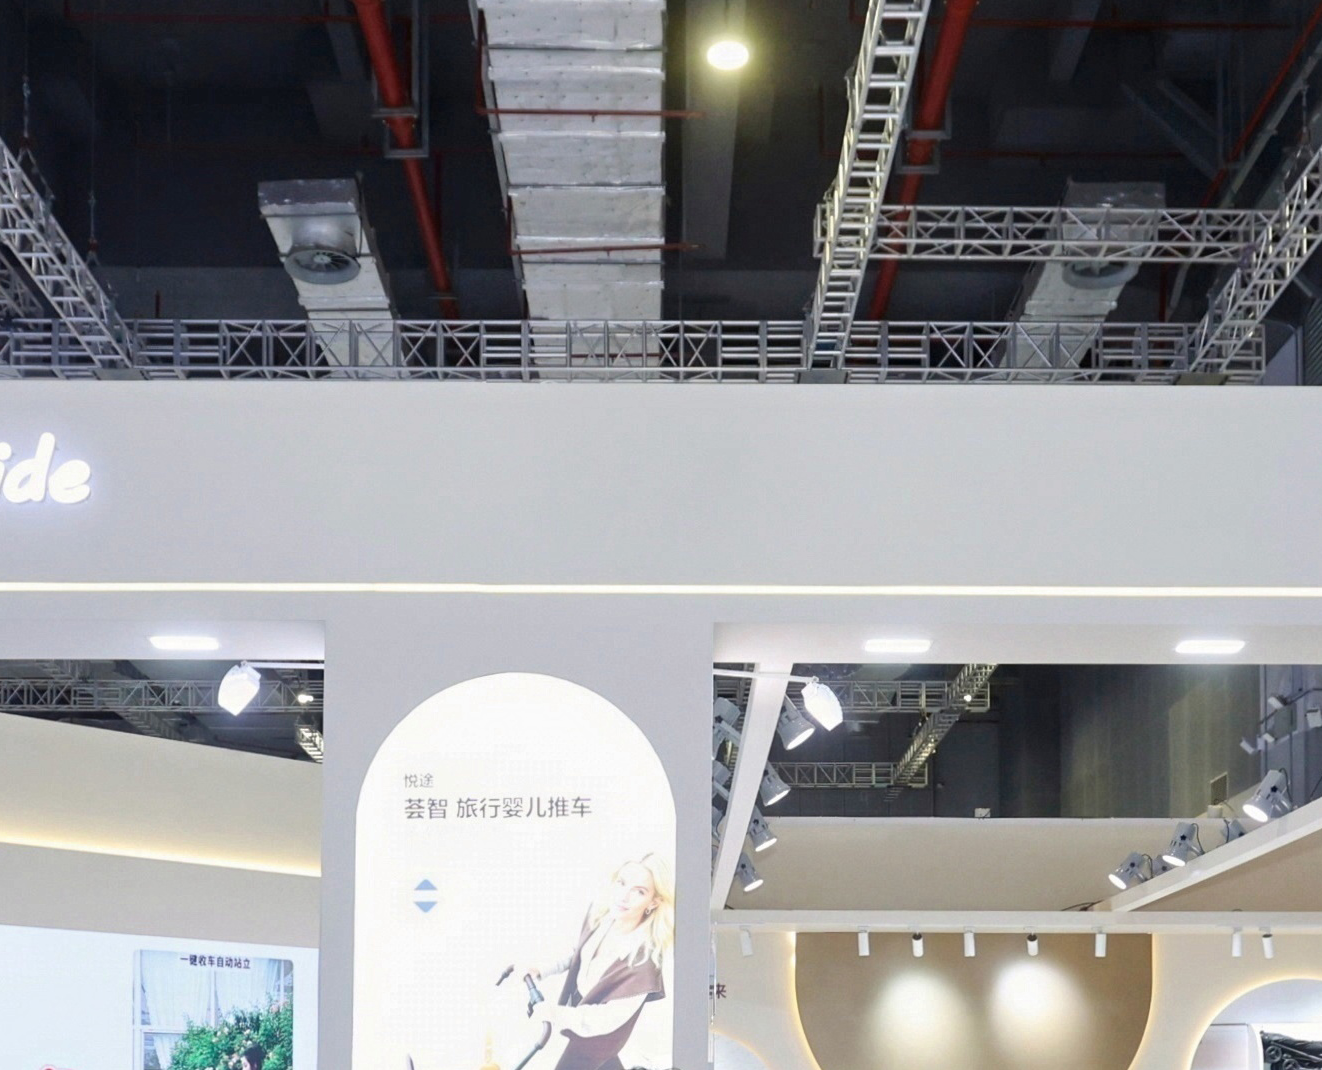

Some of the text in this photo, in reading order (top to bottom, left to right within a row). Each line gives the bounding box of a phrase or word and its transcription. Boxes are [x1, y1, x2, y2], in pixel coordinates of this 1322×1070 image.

[404, 773, 434, 789] 悦途
[404, 796, 593, 819] 荟智 旅行婴儿推车
[180, 954, 251, 969] 一键收车自动站立
